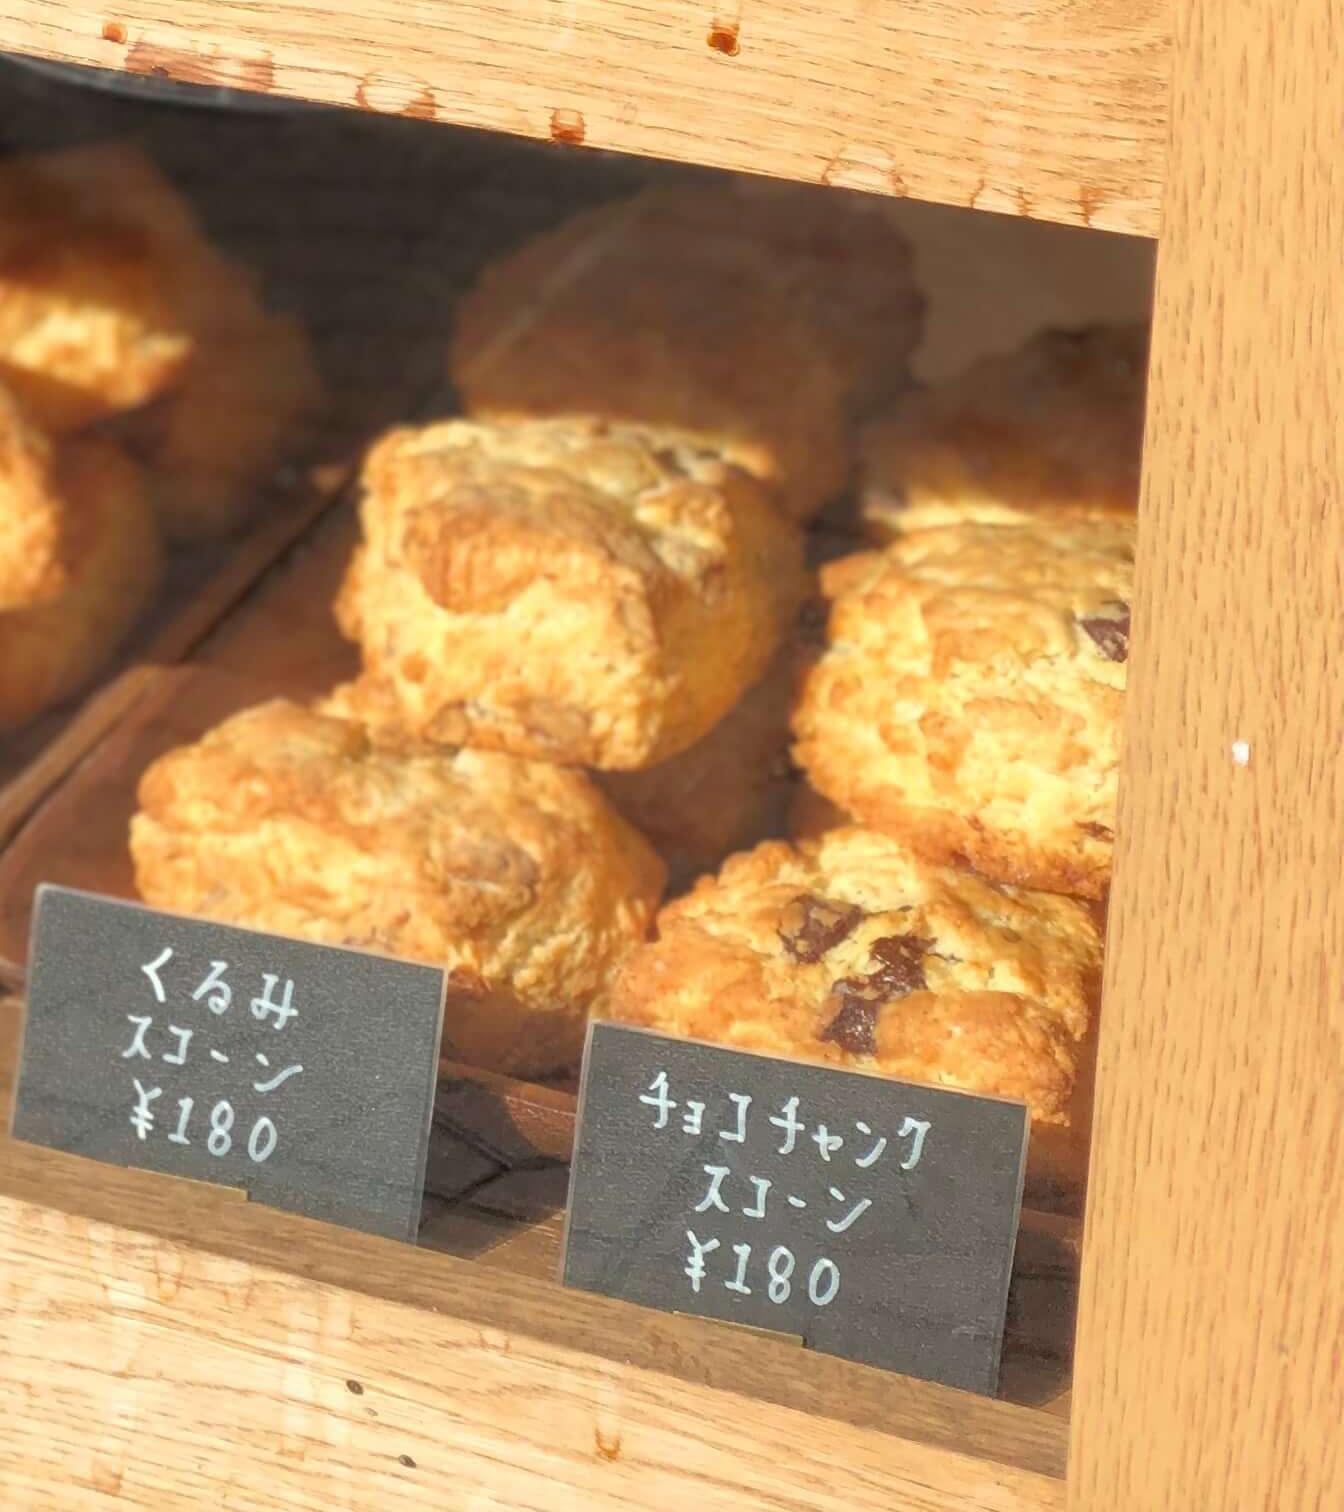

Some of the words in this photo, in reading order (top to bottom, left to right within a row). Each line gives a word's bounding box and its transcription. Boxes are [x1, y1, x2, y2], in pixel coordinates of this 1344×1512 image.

[140, 946, 299, 1030] くるみ
[121, 1014, 304, 1093] スコーン
[129, 1078, 278, 1163] ¥180
[638, 1071, 932, 1170] チョコチャンク
[694, 1163, 873, 1233] スコーン
[684, 1229, 841, 1306] ¥180
